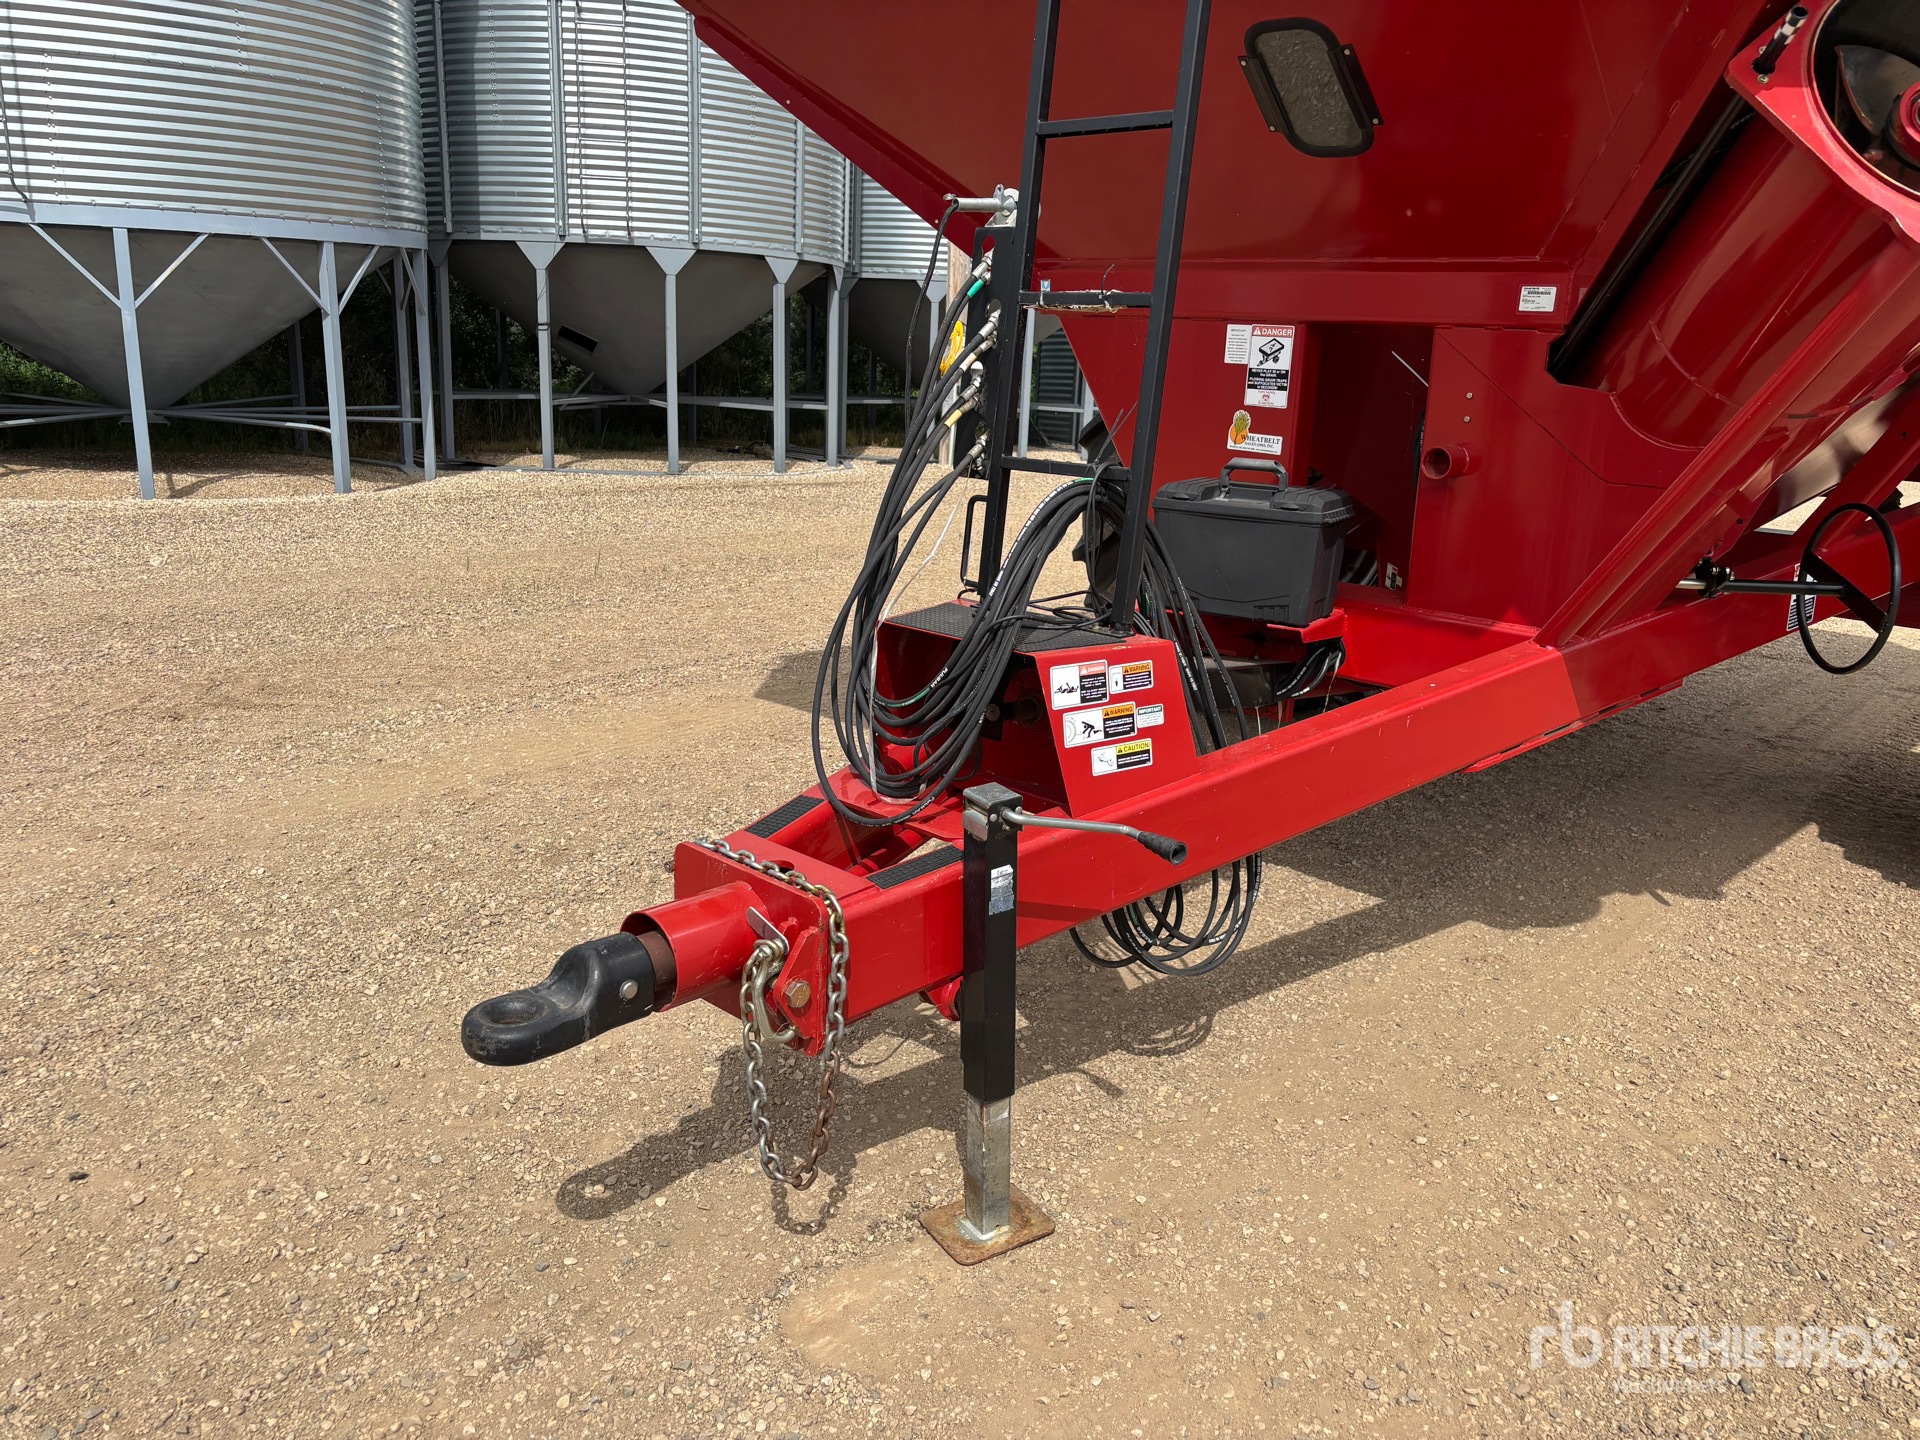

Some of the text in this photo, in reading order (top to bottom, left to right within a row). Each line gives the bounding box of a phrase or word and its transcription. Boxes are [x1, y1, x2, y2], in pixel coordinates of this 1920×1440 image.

[1241, 434, 1280, 444] WHEATBELT
[1129, 664, 1150, 672] WARNING
[930, 666, 948, 688] PULSAR
[1110, 706, 1133, 715] WARNING
[1138, 706, 1162, 714] IMPORTANT
[1123, 742, 1149, 752] CAUTION
